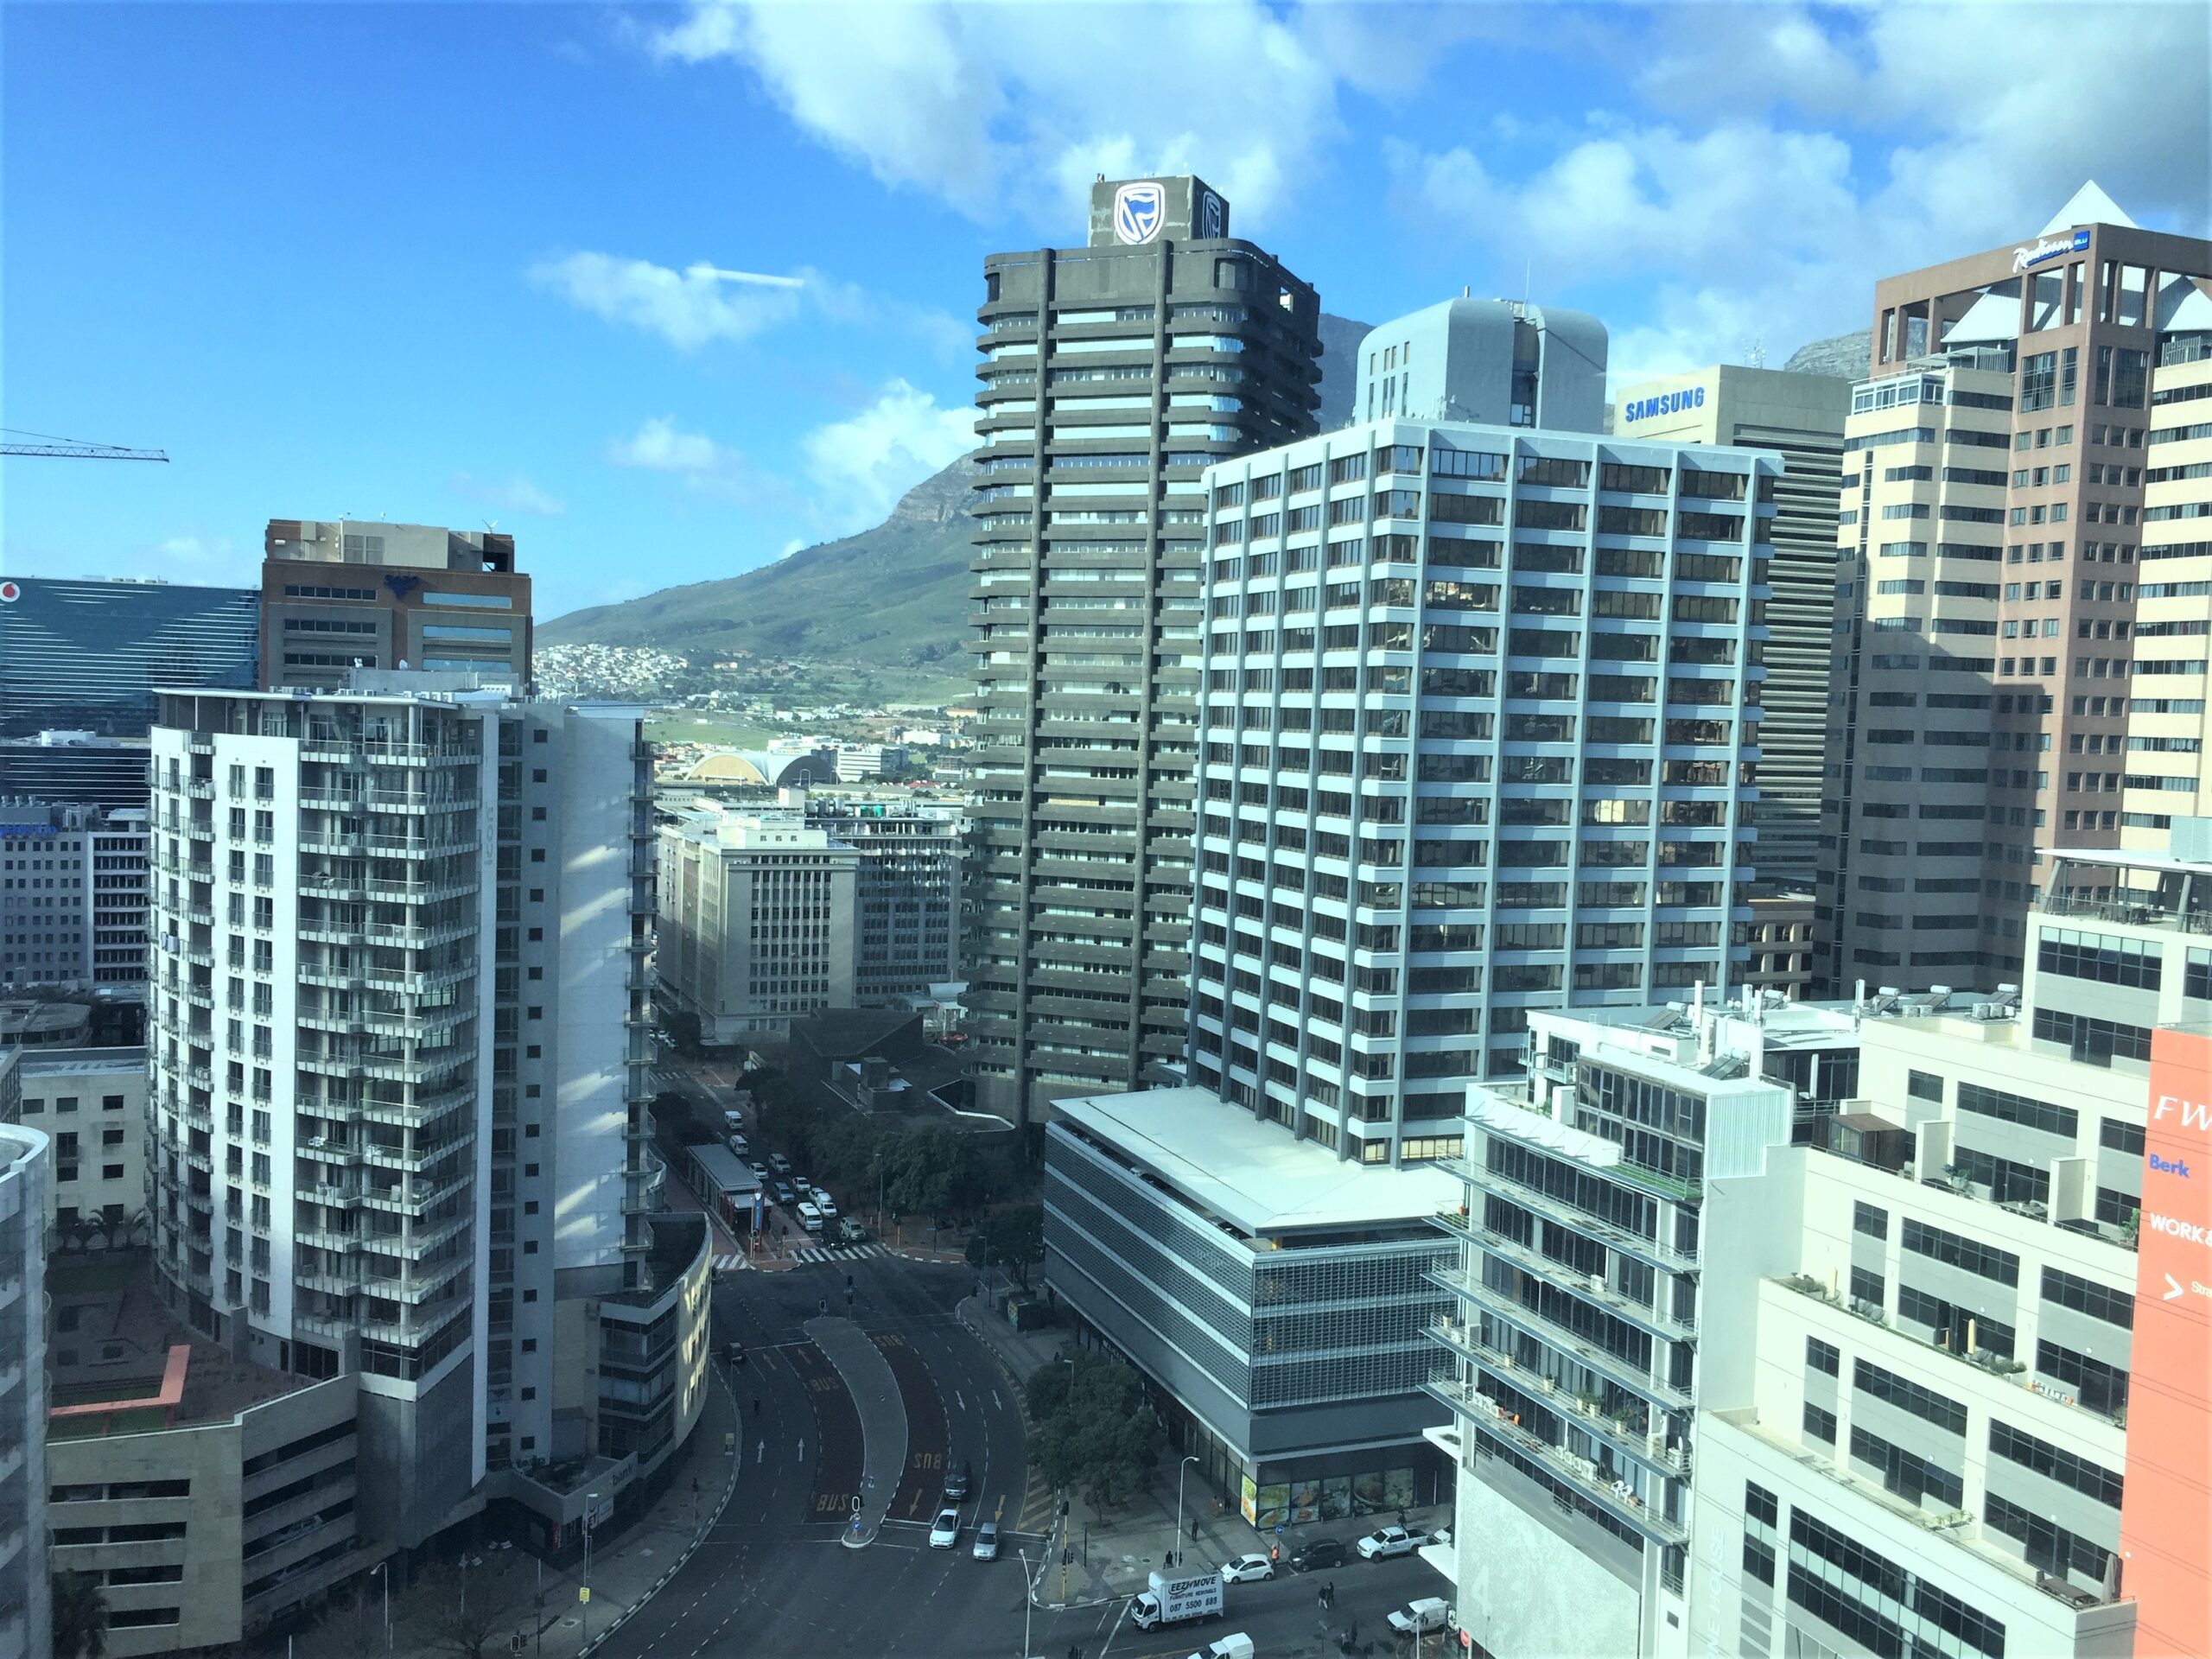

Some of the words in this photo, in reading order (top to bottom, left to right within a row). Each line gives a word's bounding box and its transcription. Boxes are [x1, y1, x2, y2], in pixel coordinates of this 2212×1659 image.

[1625, 386, 1705, 423] SAMSUNG
[2149, 1153, 2190, 1179] Berk
[914, 1452, 942, 1470] BUS
[817, 1493, 849, 1512] BUS
[1708, 1523, 1725, 1615] HOUSE
[1185, 1599, 1202, 1610] 5500
